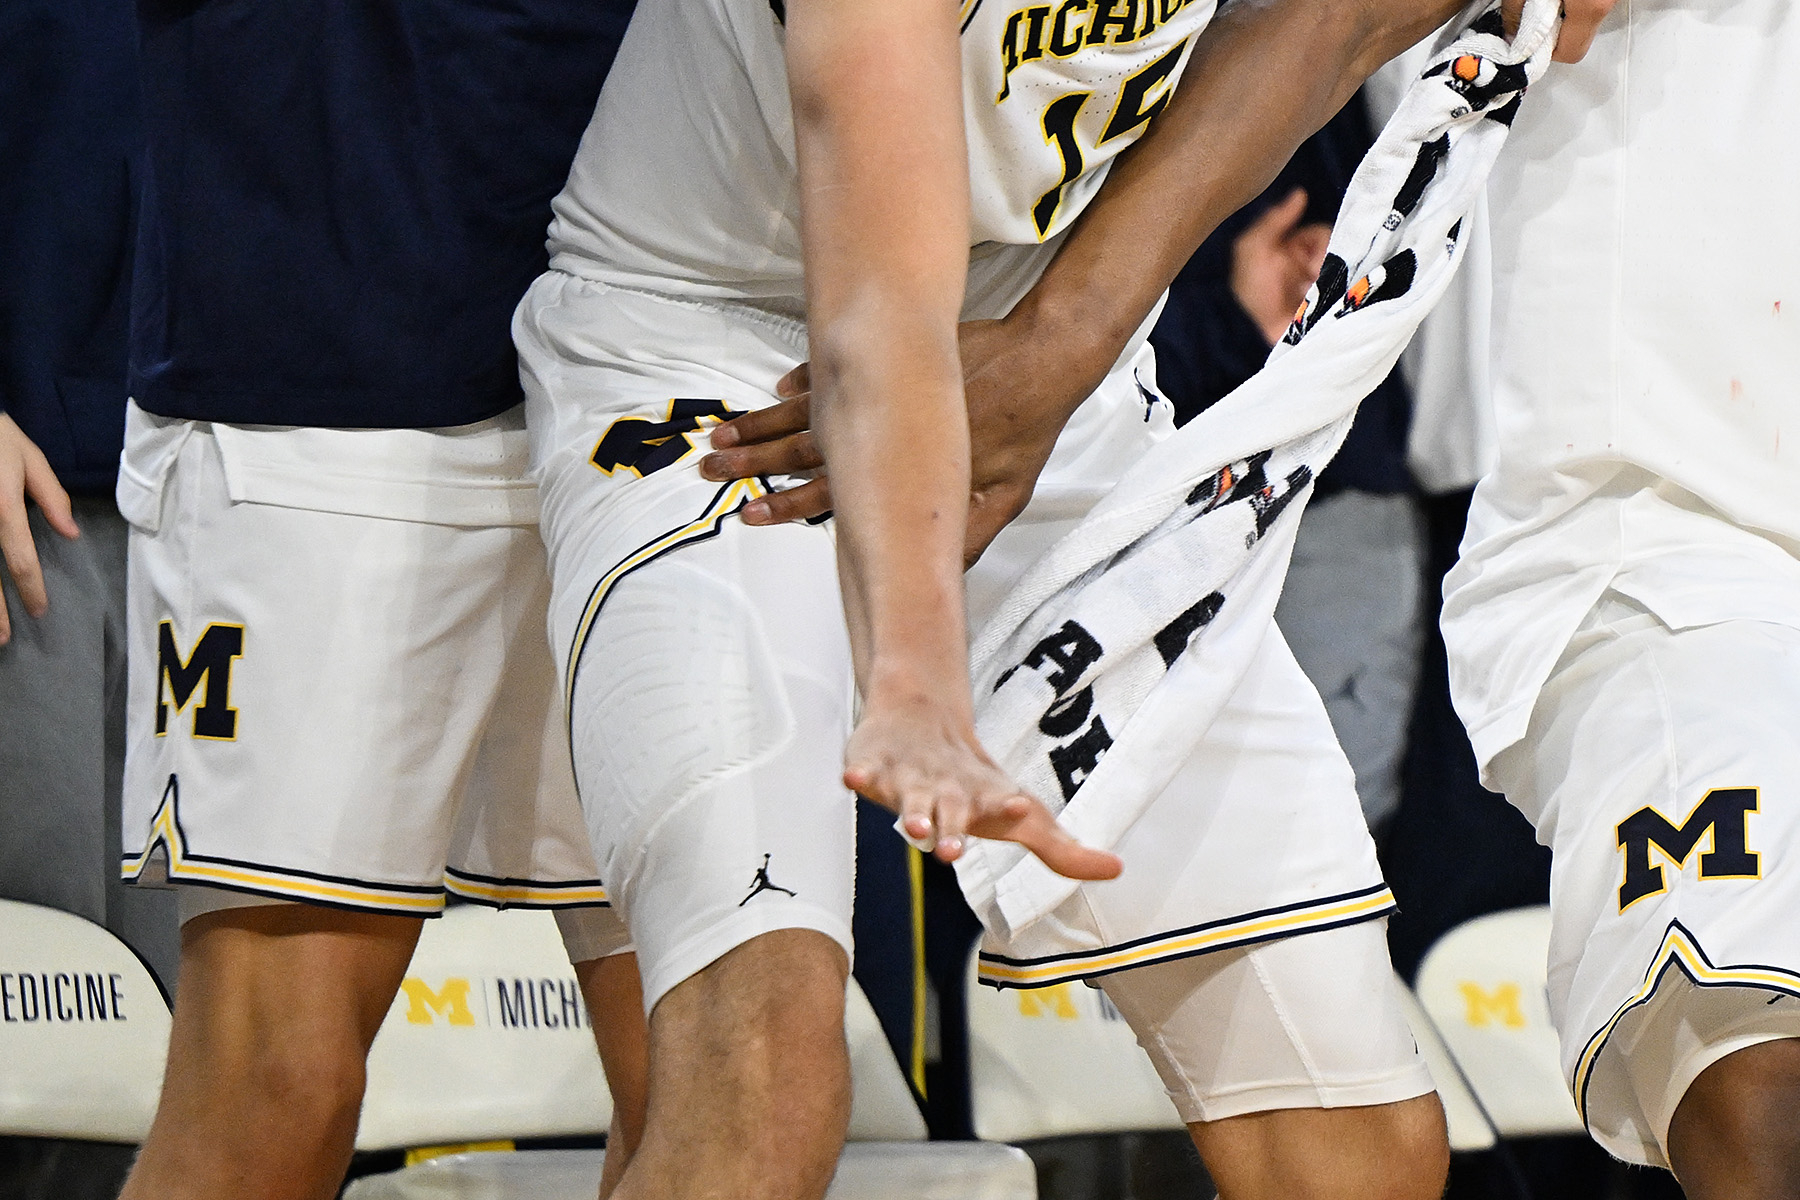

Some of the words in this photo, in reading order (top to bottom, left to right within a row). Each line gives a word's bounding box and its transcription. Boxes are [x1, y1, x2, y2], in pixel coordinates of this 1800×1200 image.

[156, 619, 246, 742] M
[1614, 786, 1762, 916] M
[0, 973, 128, 1022] EDICINE
[401, 977, 475, 1026] M
[497, 977, 592, 1029] MICH
[1458, 981, 1526, 1028] M
